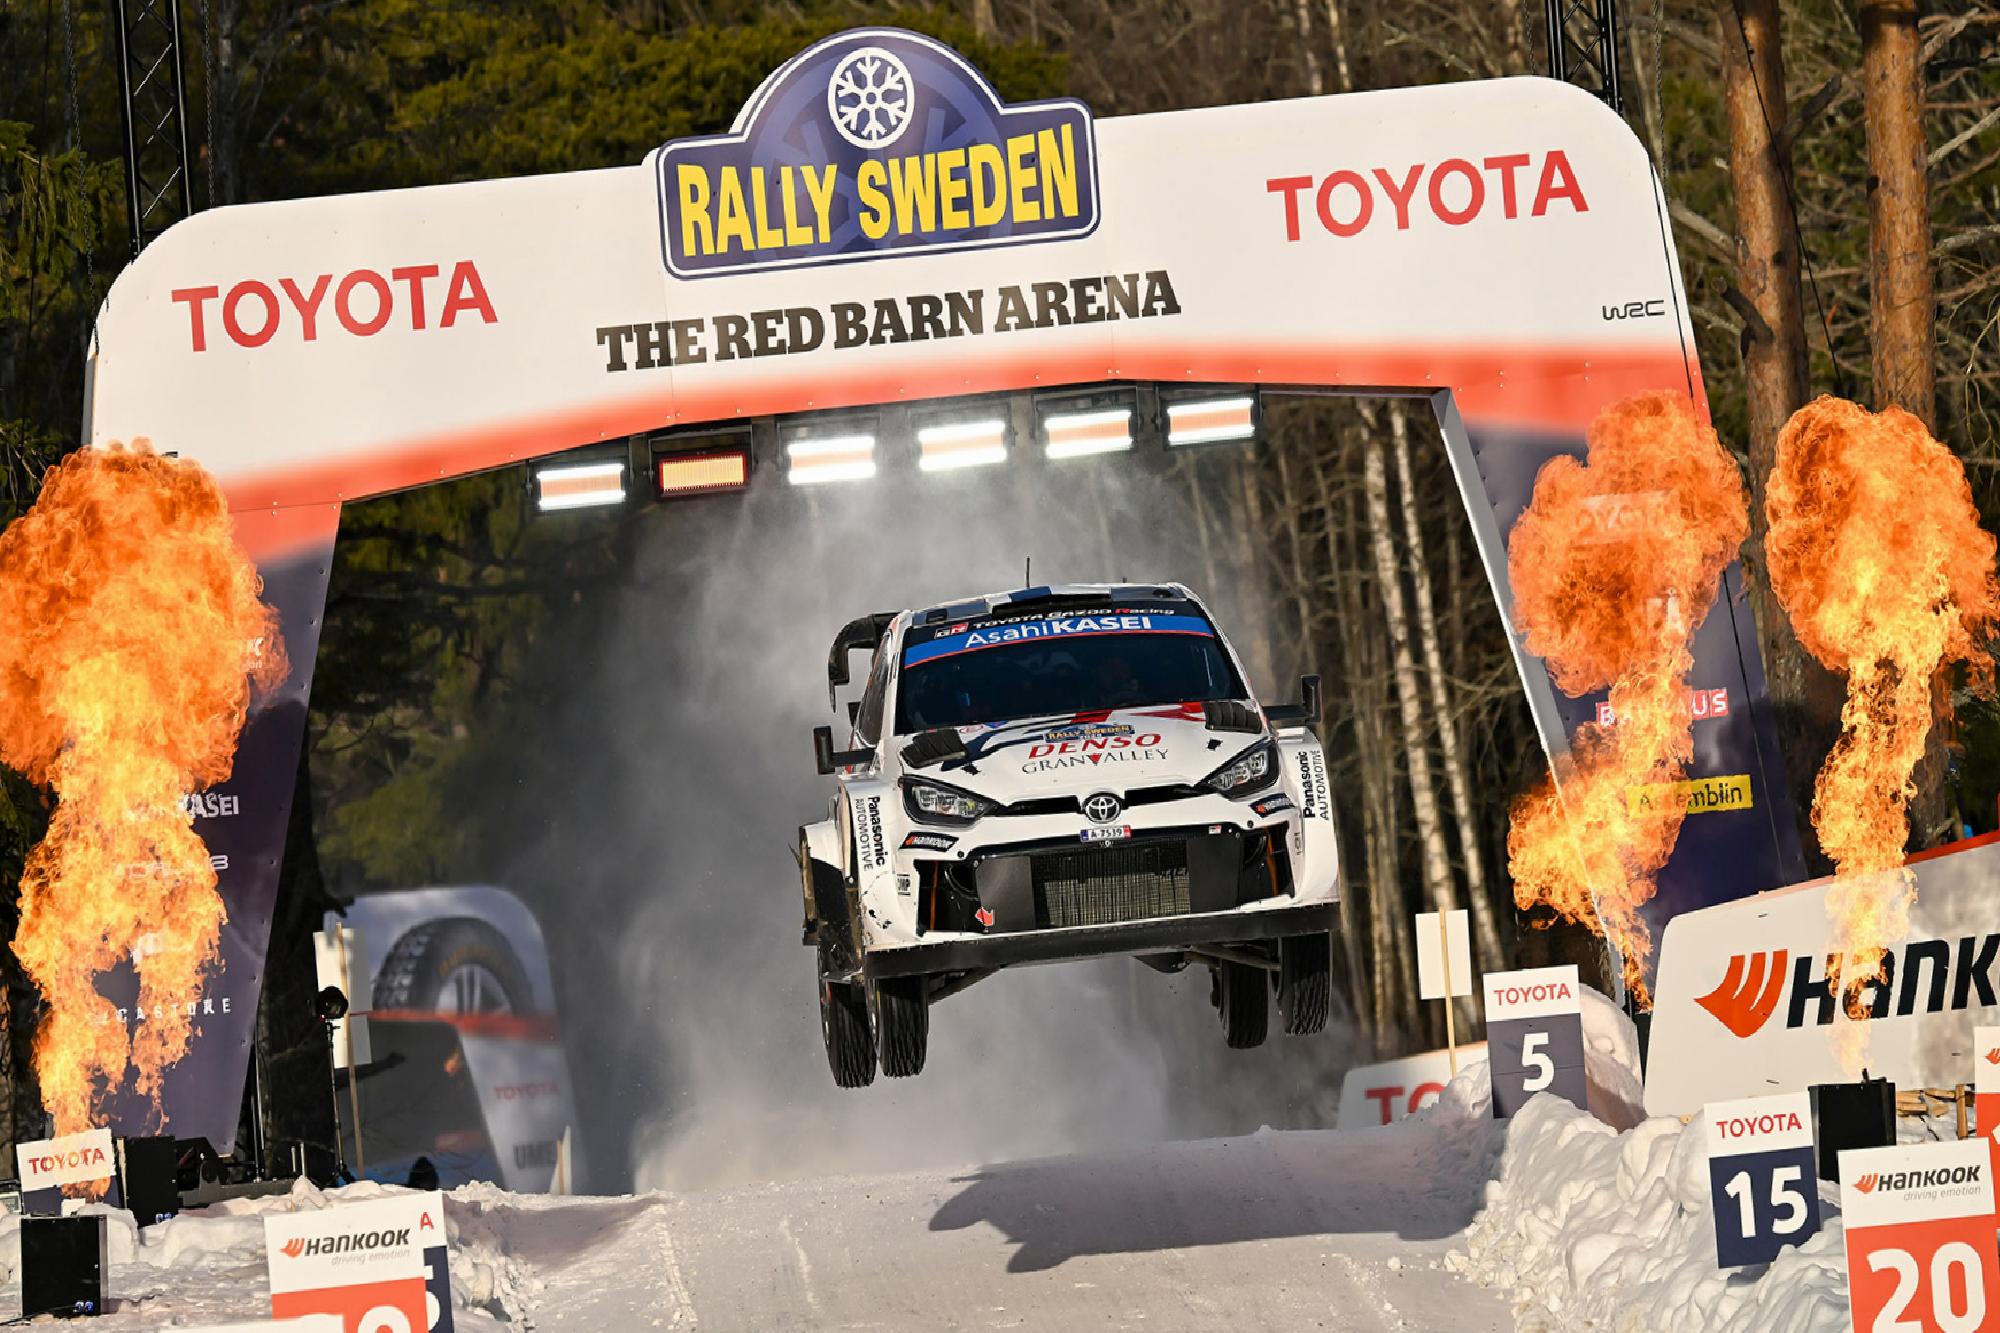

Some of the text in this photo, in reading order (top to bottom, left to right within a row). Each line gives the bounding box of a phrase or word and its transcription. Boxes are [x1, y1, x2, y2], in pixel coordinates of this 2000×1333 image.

[677, 123, 1079, 257] RALLY SWEDEN
[1266, 150, 1589, 242] TOYOTA
[171, 259, 498, 352] TOYOTA
[596, 270, 1181, 371] THE RED BARN ARENA
[1603, 300, 1665, 321] WRC
[973, 613, 1043, 629] TOYOTA
[1029, 733, 1161, 759] DENSO
[1295, 751, 1315, 818] Panasonic
[1640, 782, 1742, 813] Aemblin
[856, 798, 873, 871] AUTOMOTIVE
[868, 796, 888, 867] Panasonic
[1494, 982, 1571, 1006] TOYOTA
[1521, 1032, 1554, 1092] 5
[1716, 1112, 1802, 1139] TOYOTA
[29, 1148, 105, 1175] TOYOTA
[1724, 1165, 1808, 1238] 15
[1903, 1186, 1981, 1202] driving emotion
[331, 1249, 410, 1266] driving emotion
[1866, 1241, 1986, 1333] 20
